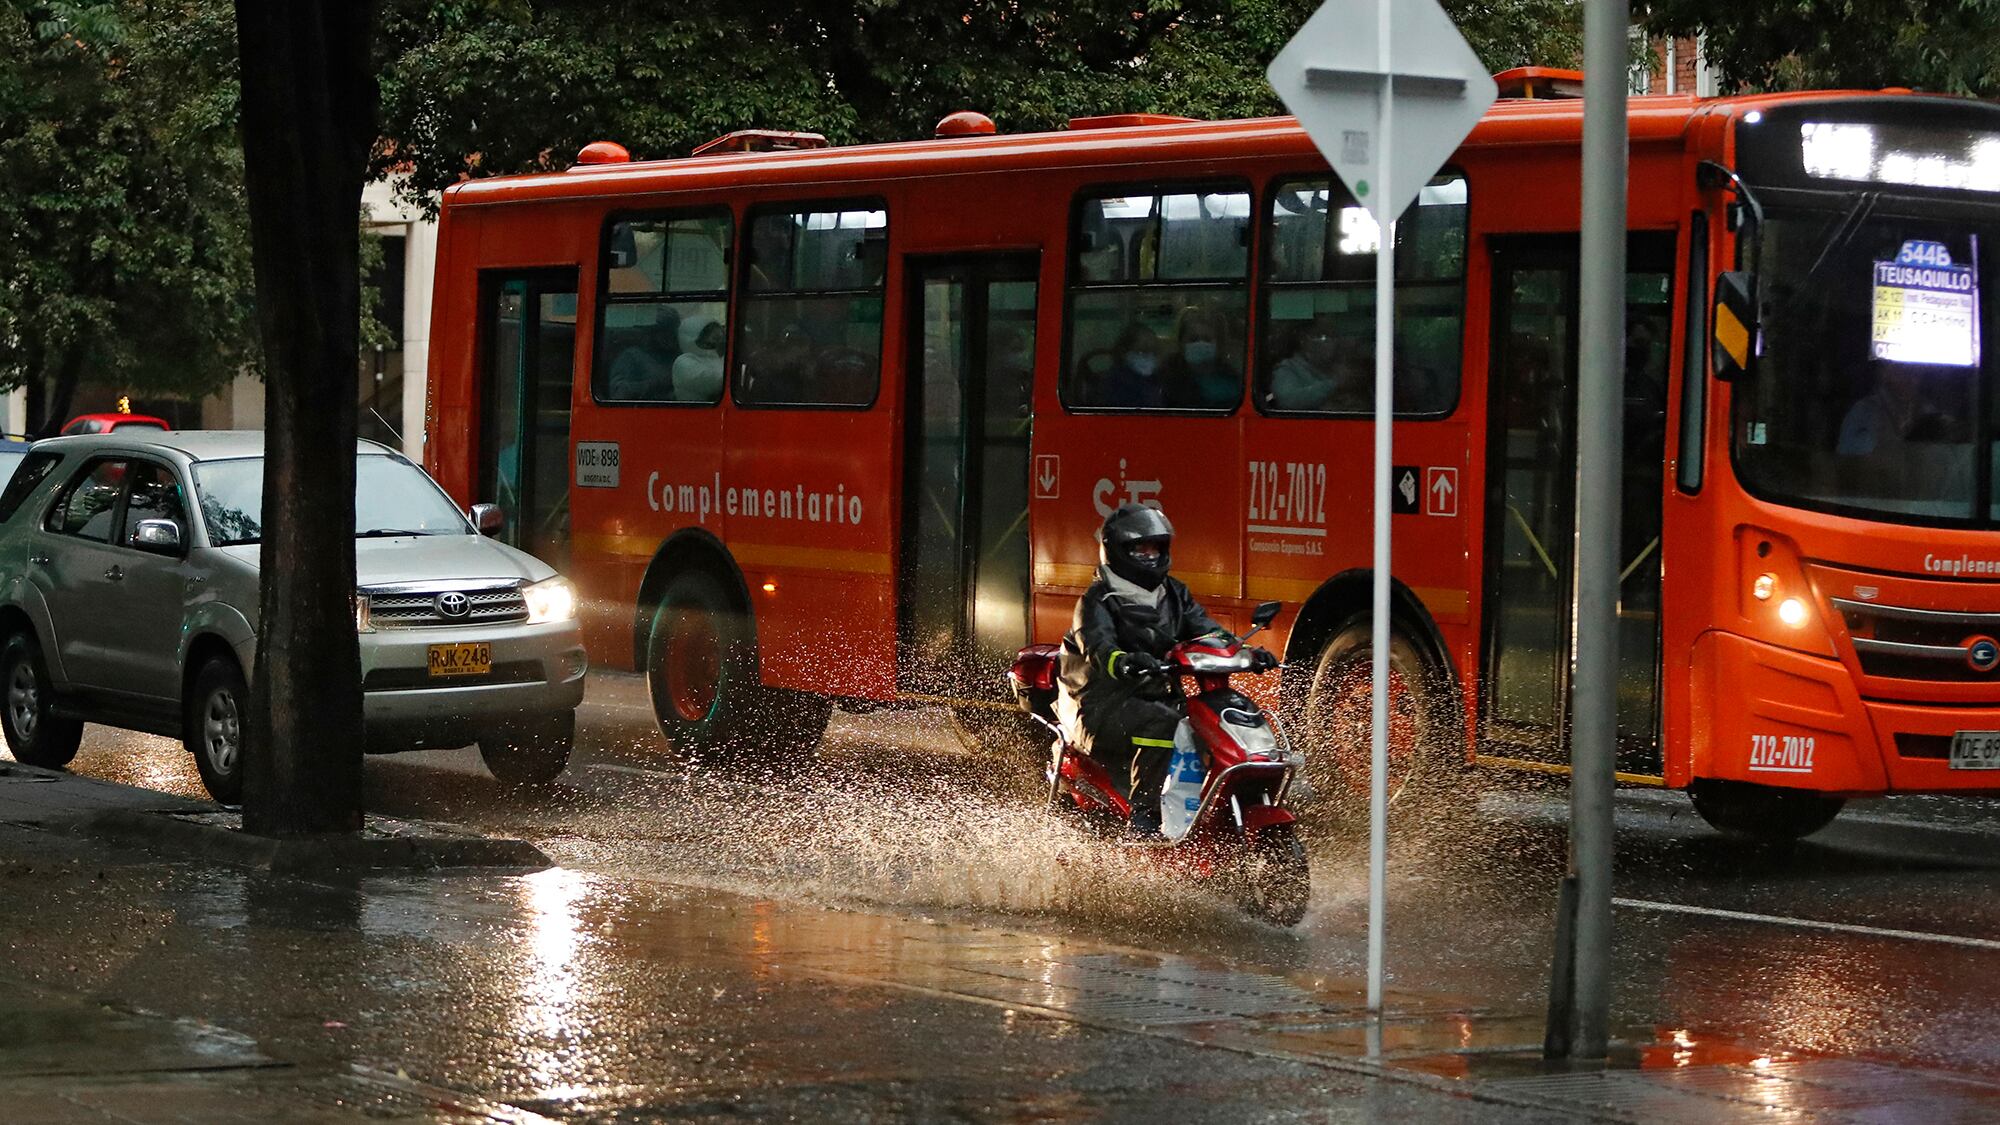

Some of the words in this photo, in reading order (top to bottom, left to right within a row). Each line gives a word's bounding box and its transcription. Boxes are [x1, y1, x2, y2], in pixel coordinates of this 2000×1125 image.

[1902, 242, 1951, 266] 544B
[1879, 266, 1971, 290] TEUSAQUILLO
[647, 471, 862, 524] Complementario
[1248, 461, 1326, 523] Z12-7012
[1750, 735, 1814, 766] Z12-7012
